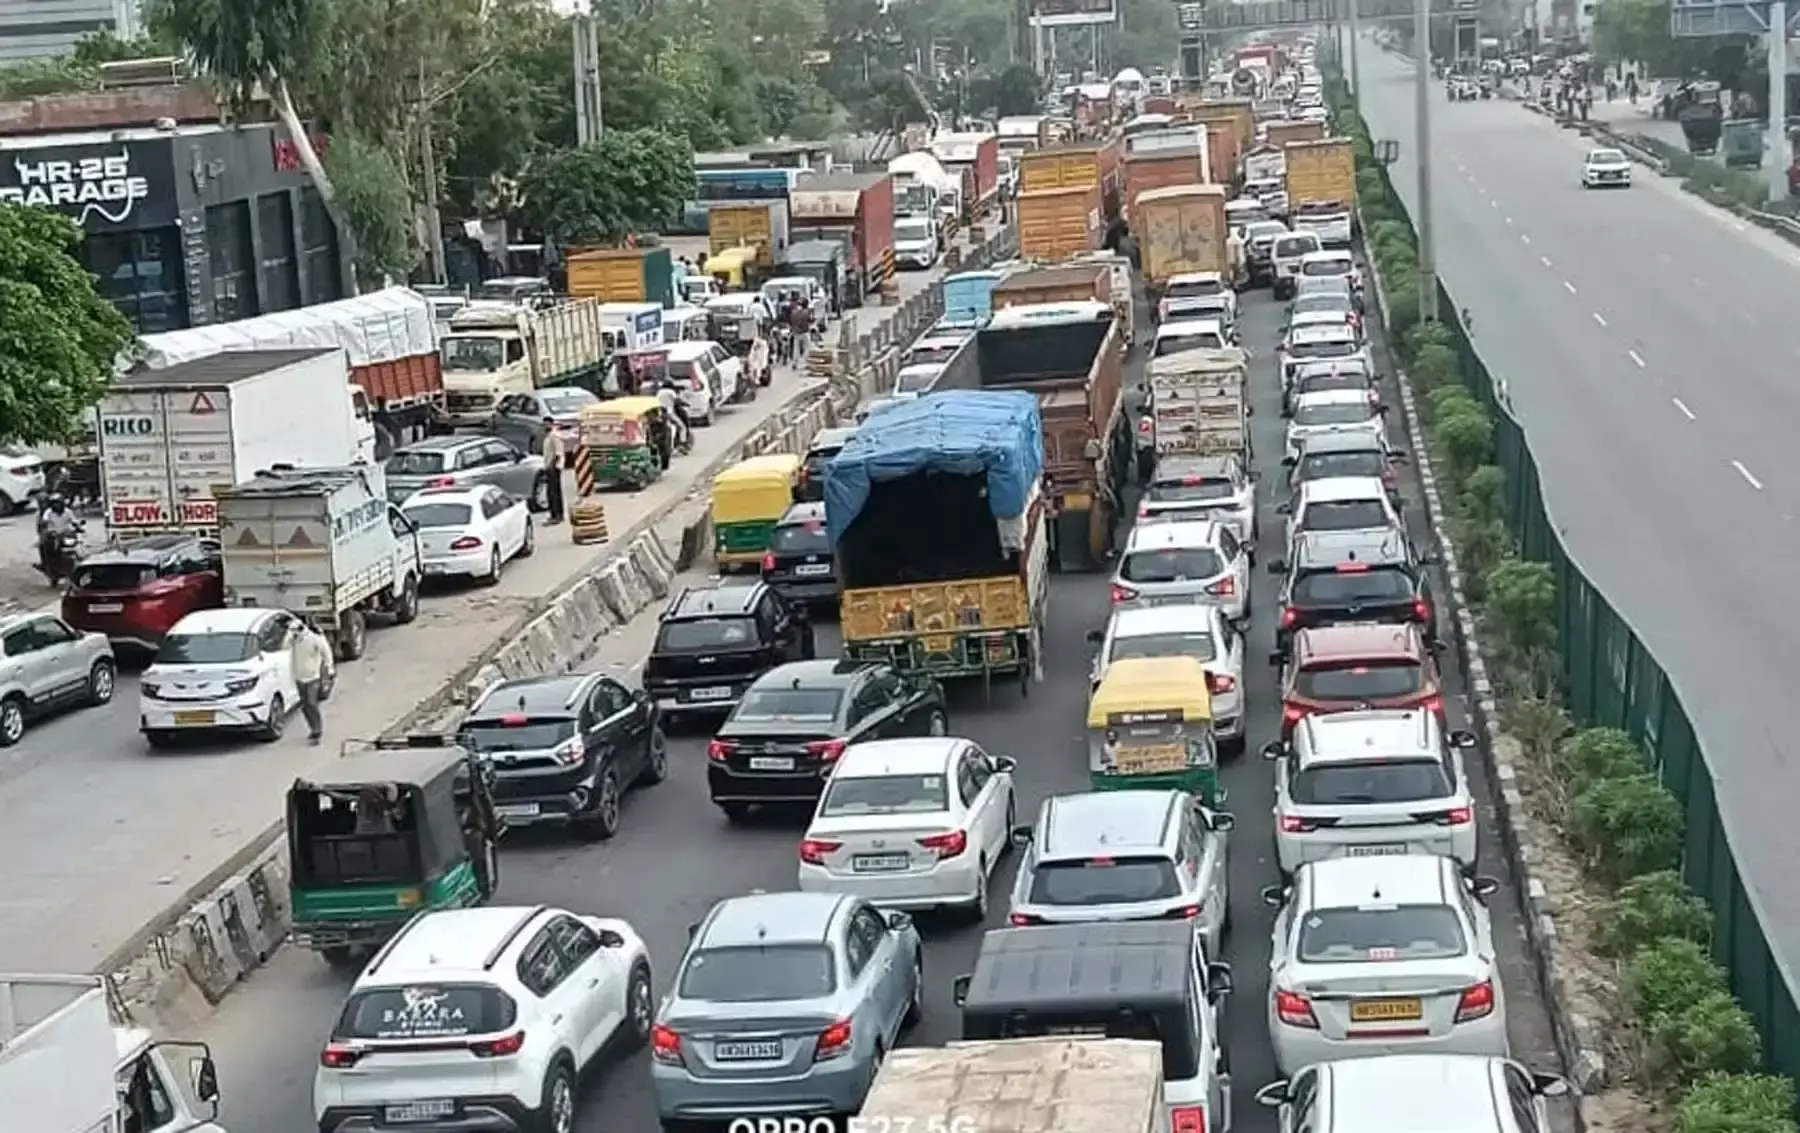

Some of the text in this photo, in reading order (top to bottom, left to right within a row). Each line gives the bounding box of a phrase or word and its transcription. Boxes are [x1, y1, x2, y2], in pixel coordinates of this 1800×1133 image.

[15, 152, 129, 185] HR-26
[0, 177, 148, 206] GARAGE
[104, 418, 153, 435] RICO
[113, 503, 217, 523] BLOW HOR
